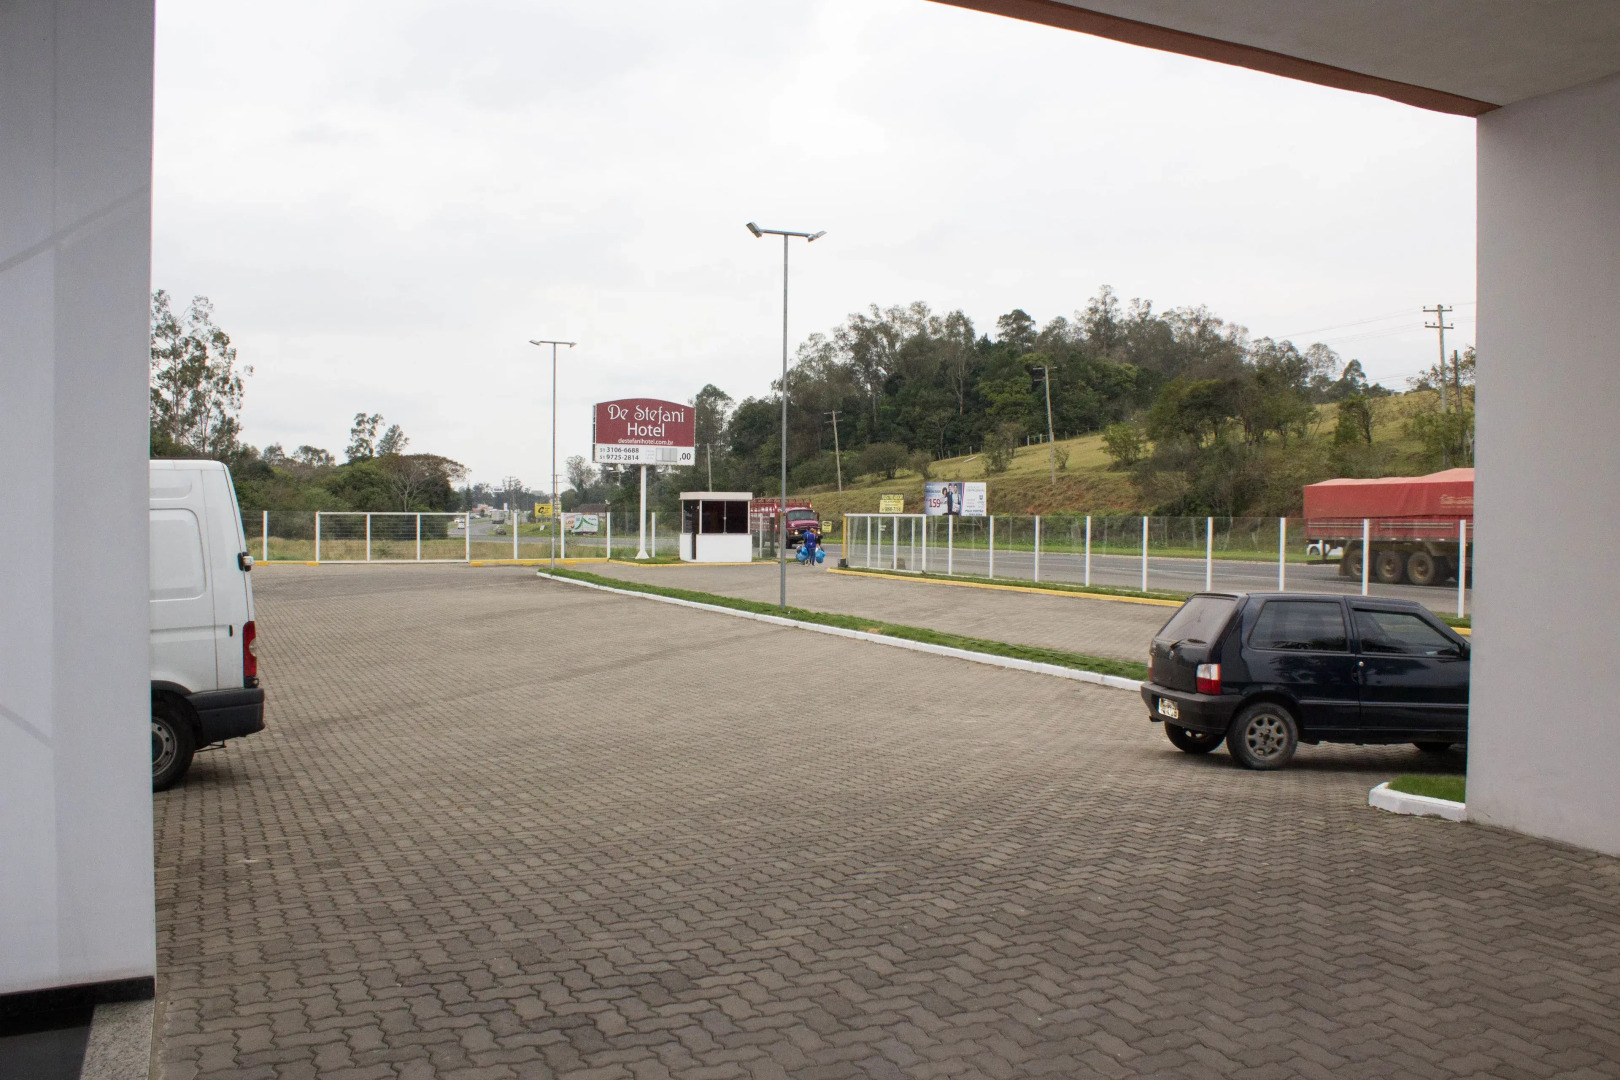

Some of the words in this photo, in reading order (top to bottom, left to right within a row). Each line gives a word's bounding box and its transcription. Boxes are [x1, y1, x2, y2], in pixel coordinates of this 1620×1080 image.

[607, 404, 629, 420] De
[634, 404, 685, 425] Stefani
[627, 422, 665, 437] Hotel
[617, 437, 674, 446] destefanihotel.com.br
[928, 498, 941, 508] 159
